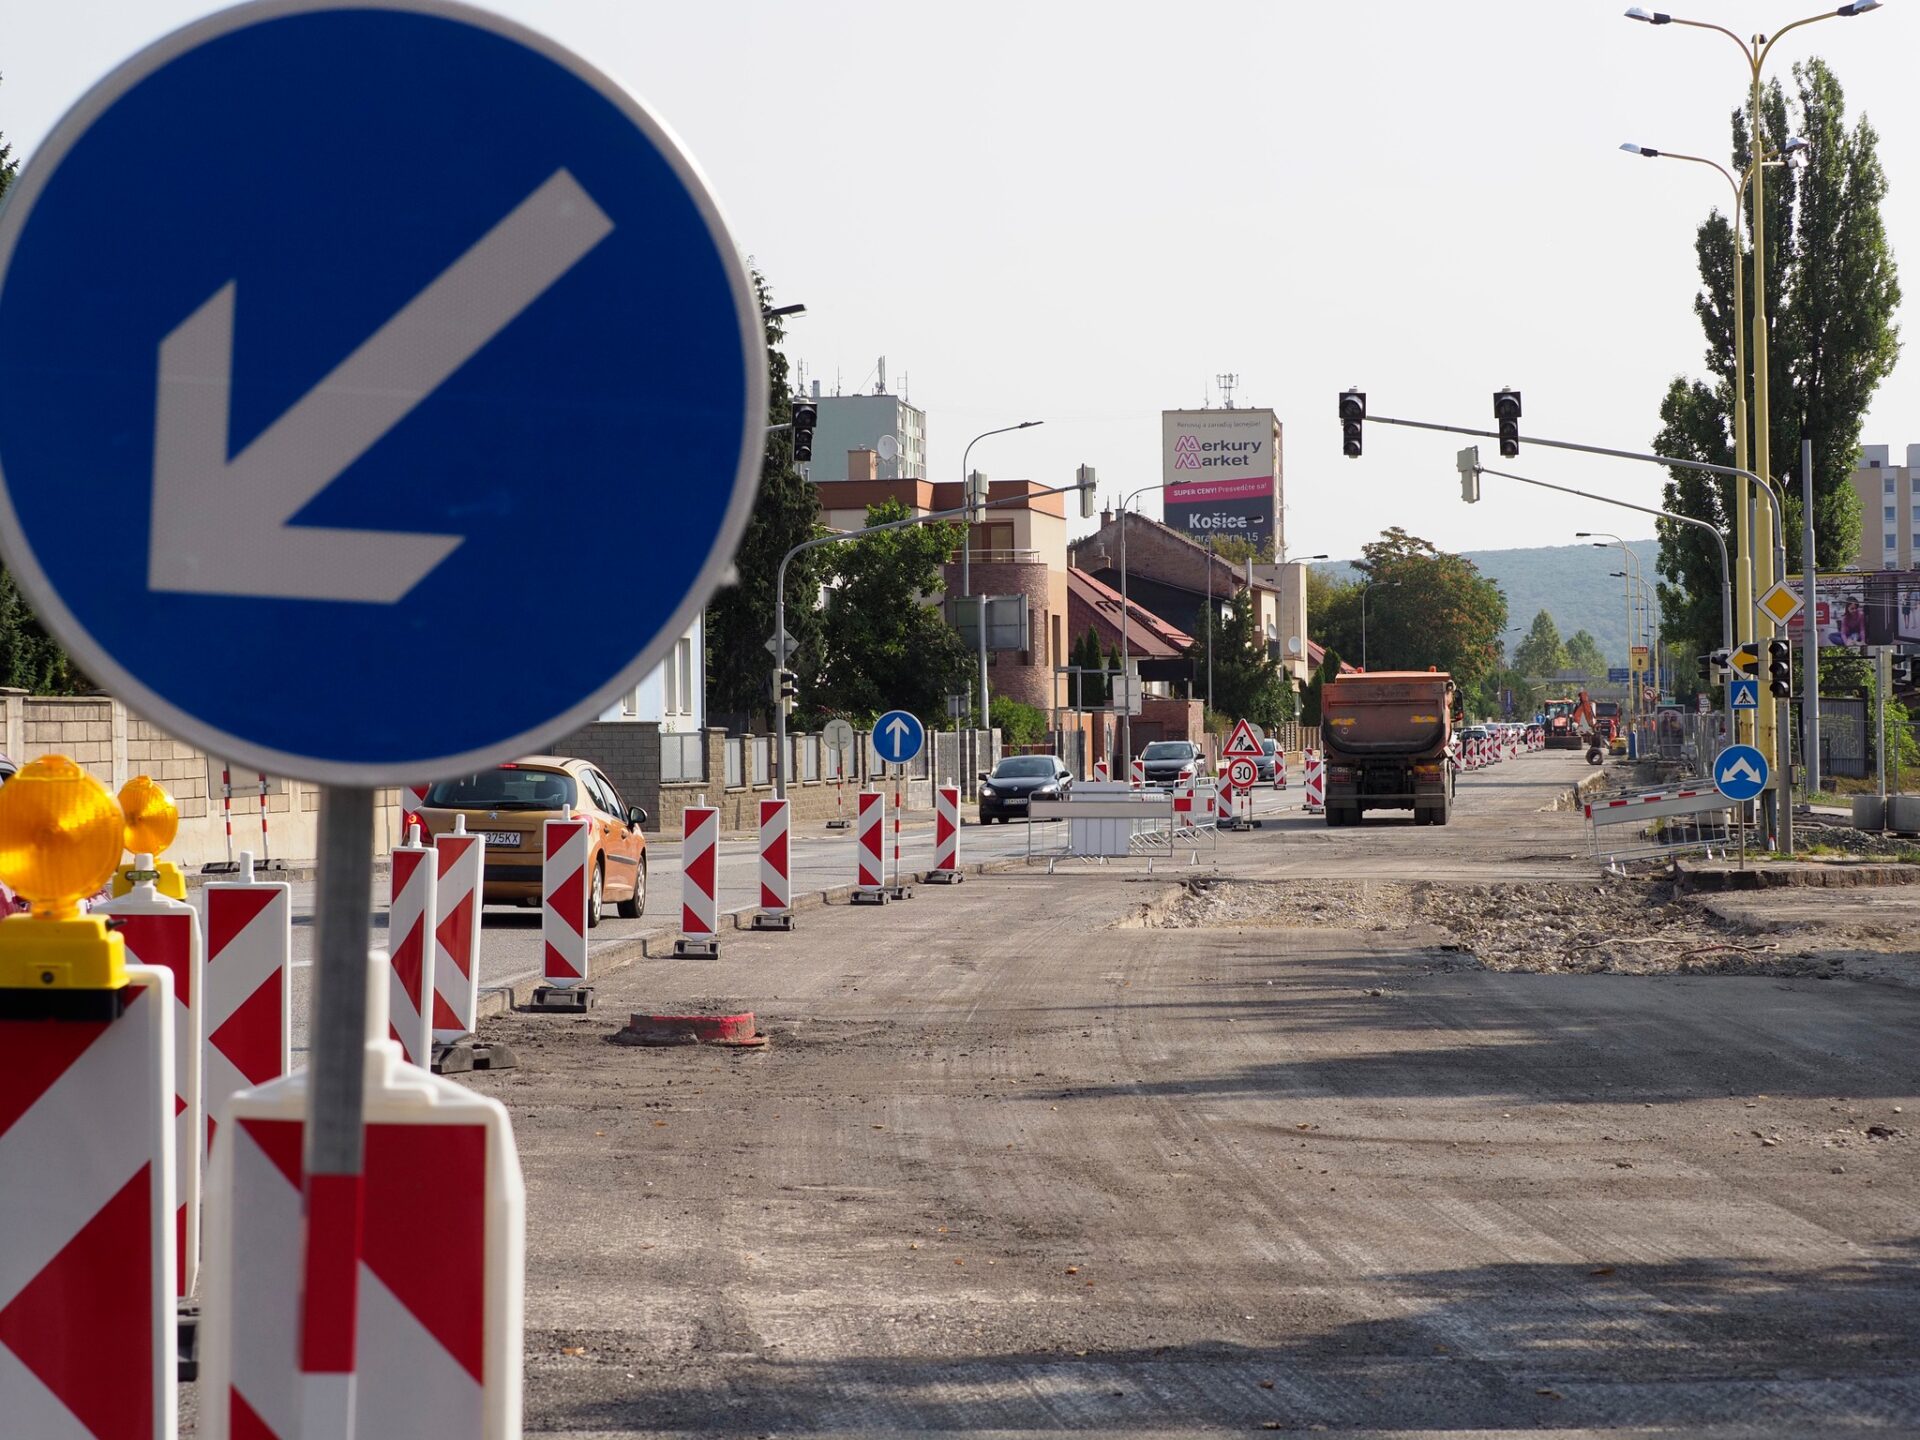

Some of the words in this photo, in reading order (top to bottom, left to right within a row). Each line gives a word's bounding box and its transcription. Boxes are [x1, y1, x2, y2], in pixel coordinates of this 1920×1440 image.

[1175, 435, 1262, 454] Merkury
[1175, 452, 1249, 469] Market
[1173, 488, 1196, 496] SUPER
[1197, 487, 1217, 495] CENY!
[1256, 482, 1267, 490] sa!
[1189, 512, 1248, 529] Košice
[1246, 532, 1259, 542] 15
[1234, 766, 1252, 780] 30
